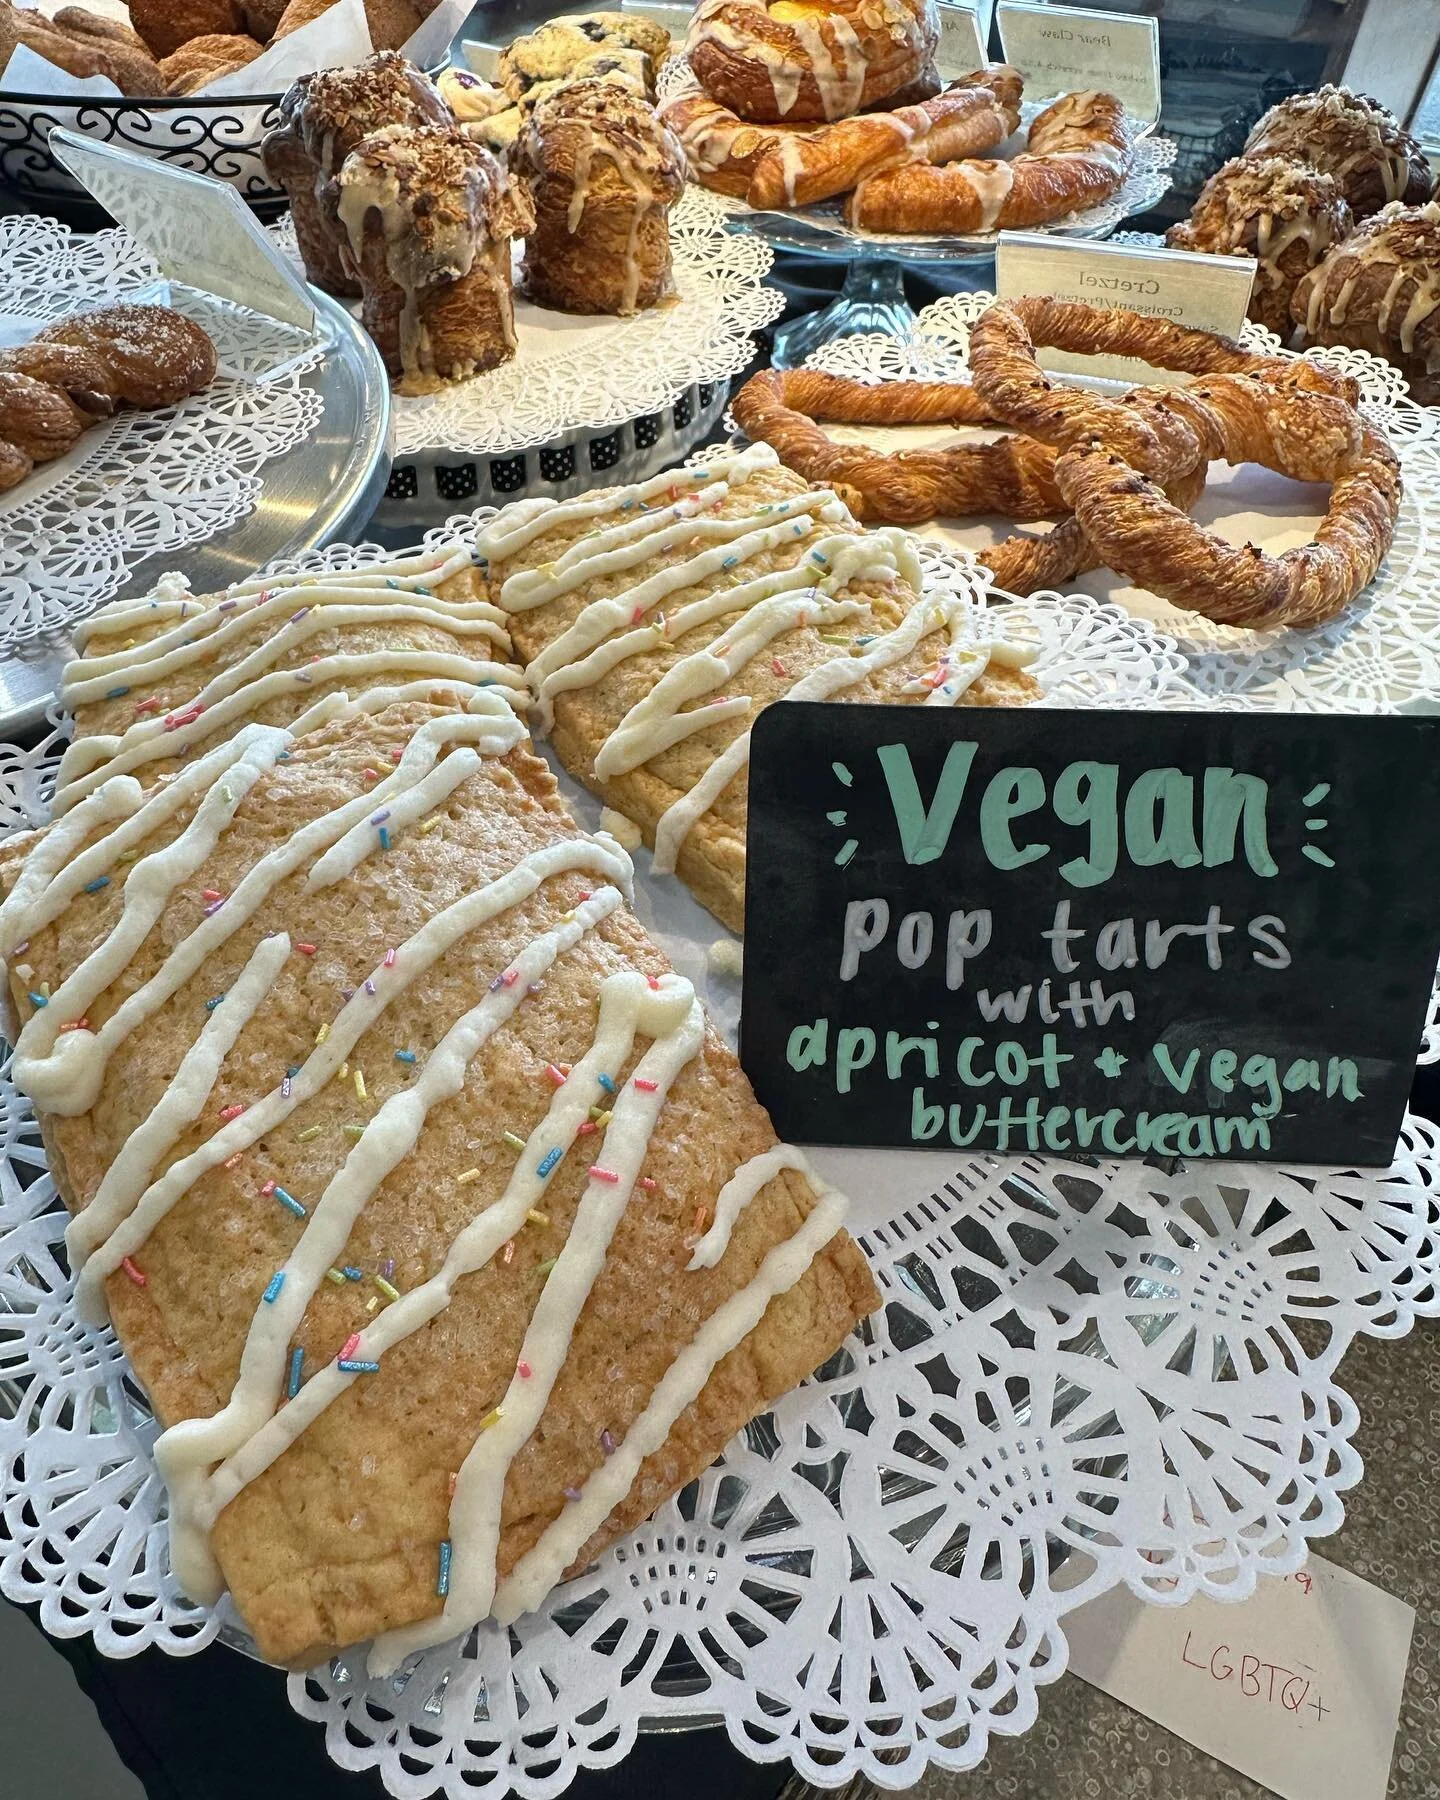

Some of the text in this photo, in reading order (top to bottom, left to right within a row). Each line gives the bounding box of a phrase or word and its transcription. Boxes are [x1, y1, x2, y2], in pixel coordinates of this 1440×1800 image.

[877, 741, 1279, 888] Vegan
[1040, 899, 1292, 973] tarts
[977, 978, 1136, 1028] with
[786, 1017, 1075, 1093] apricot
[911, 1086, 1272, 1157] buttercream
[1182, 1630, 1331, 1722] LGBTQ+
